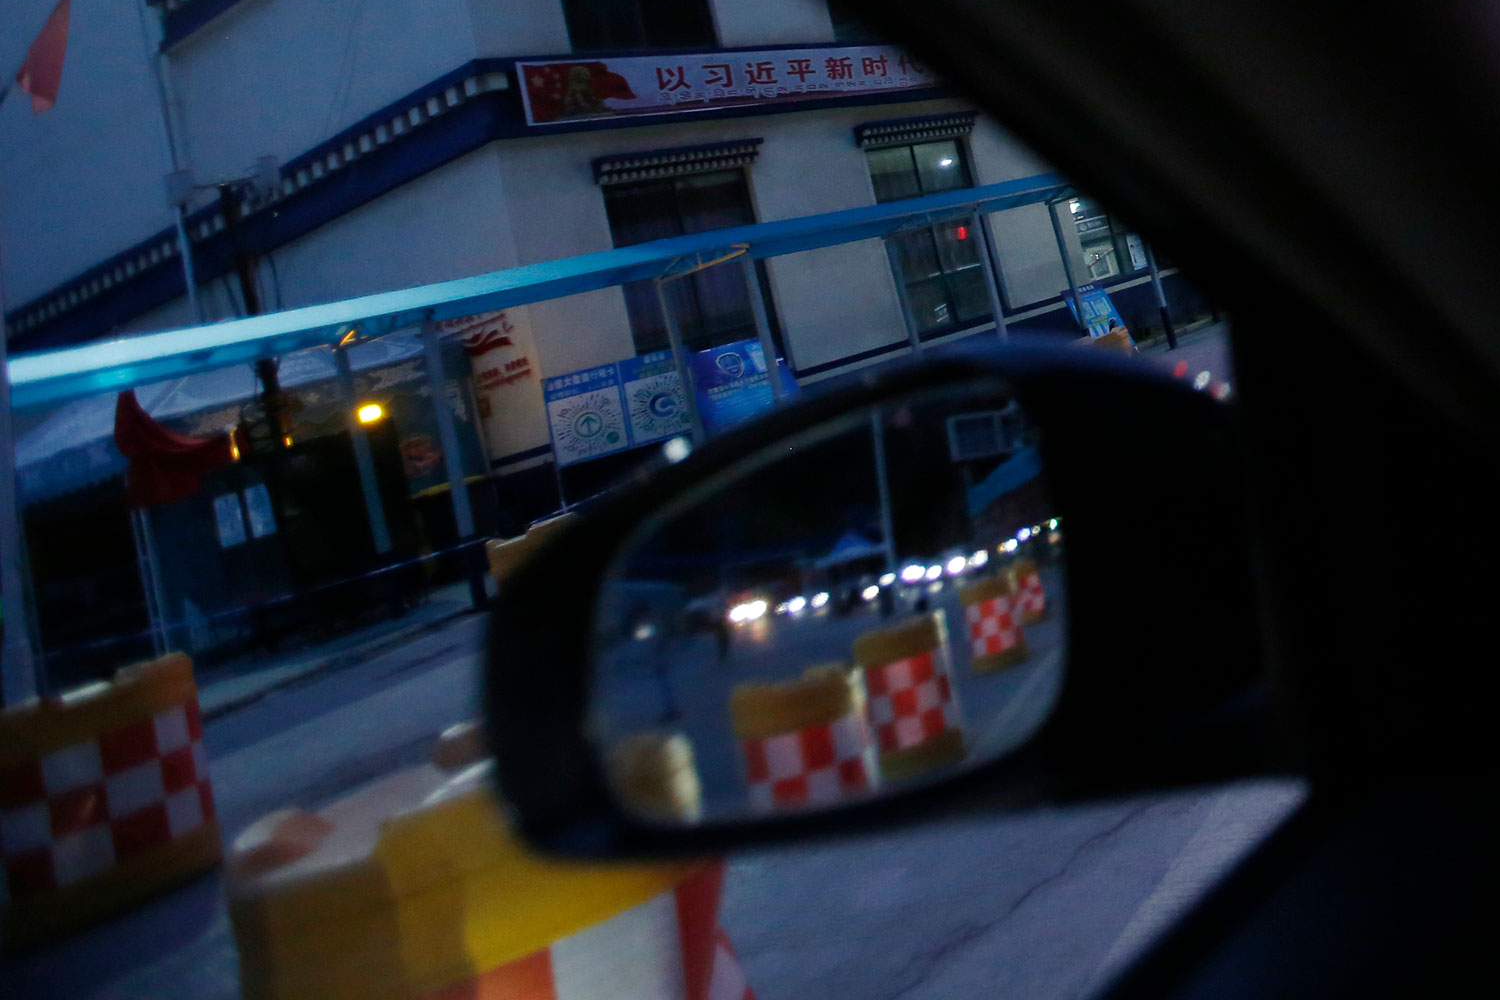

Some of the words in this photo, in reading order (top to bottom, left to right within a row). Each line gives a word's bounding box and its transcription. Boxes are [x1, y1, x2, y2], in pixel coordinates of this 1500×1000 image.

[655, 53, 926, 92] 以习近平新时代
